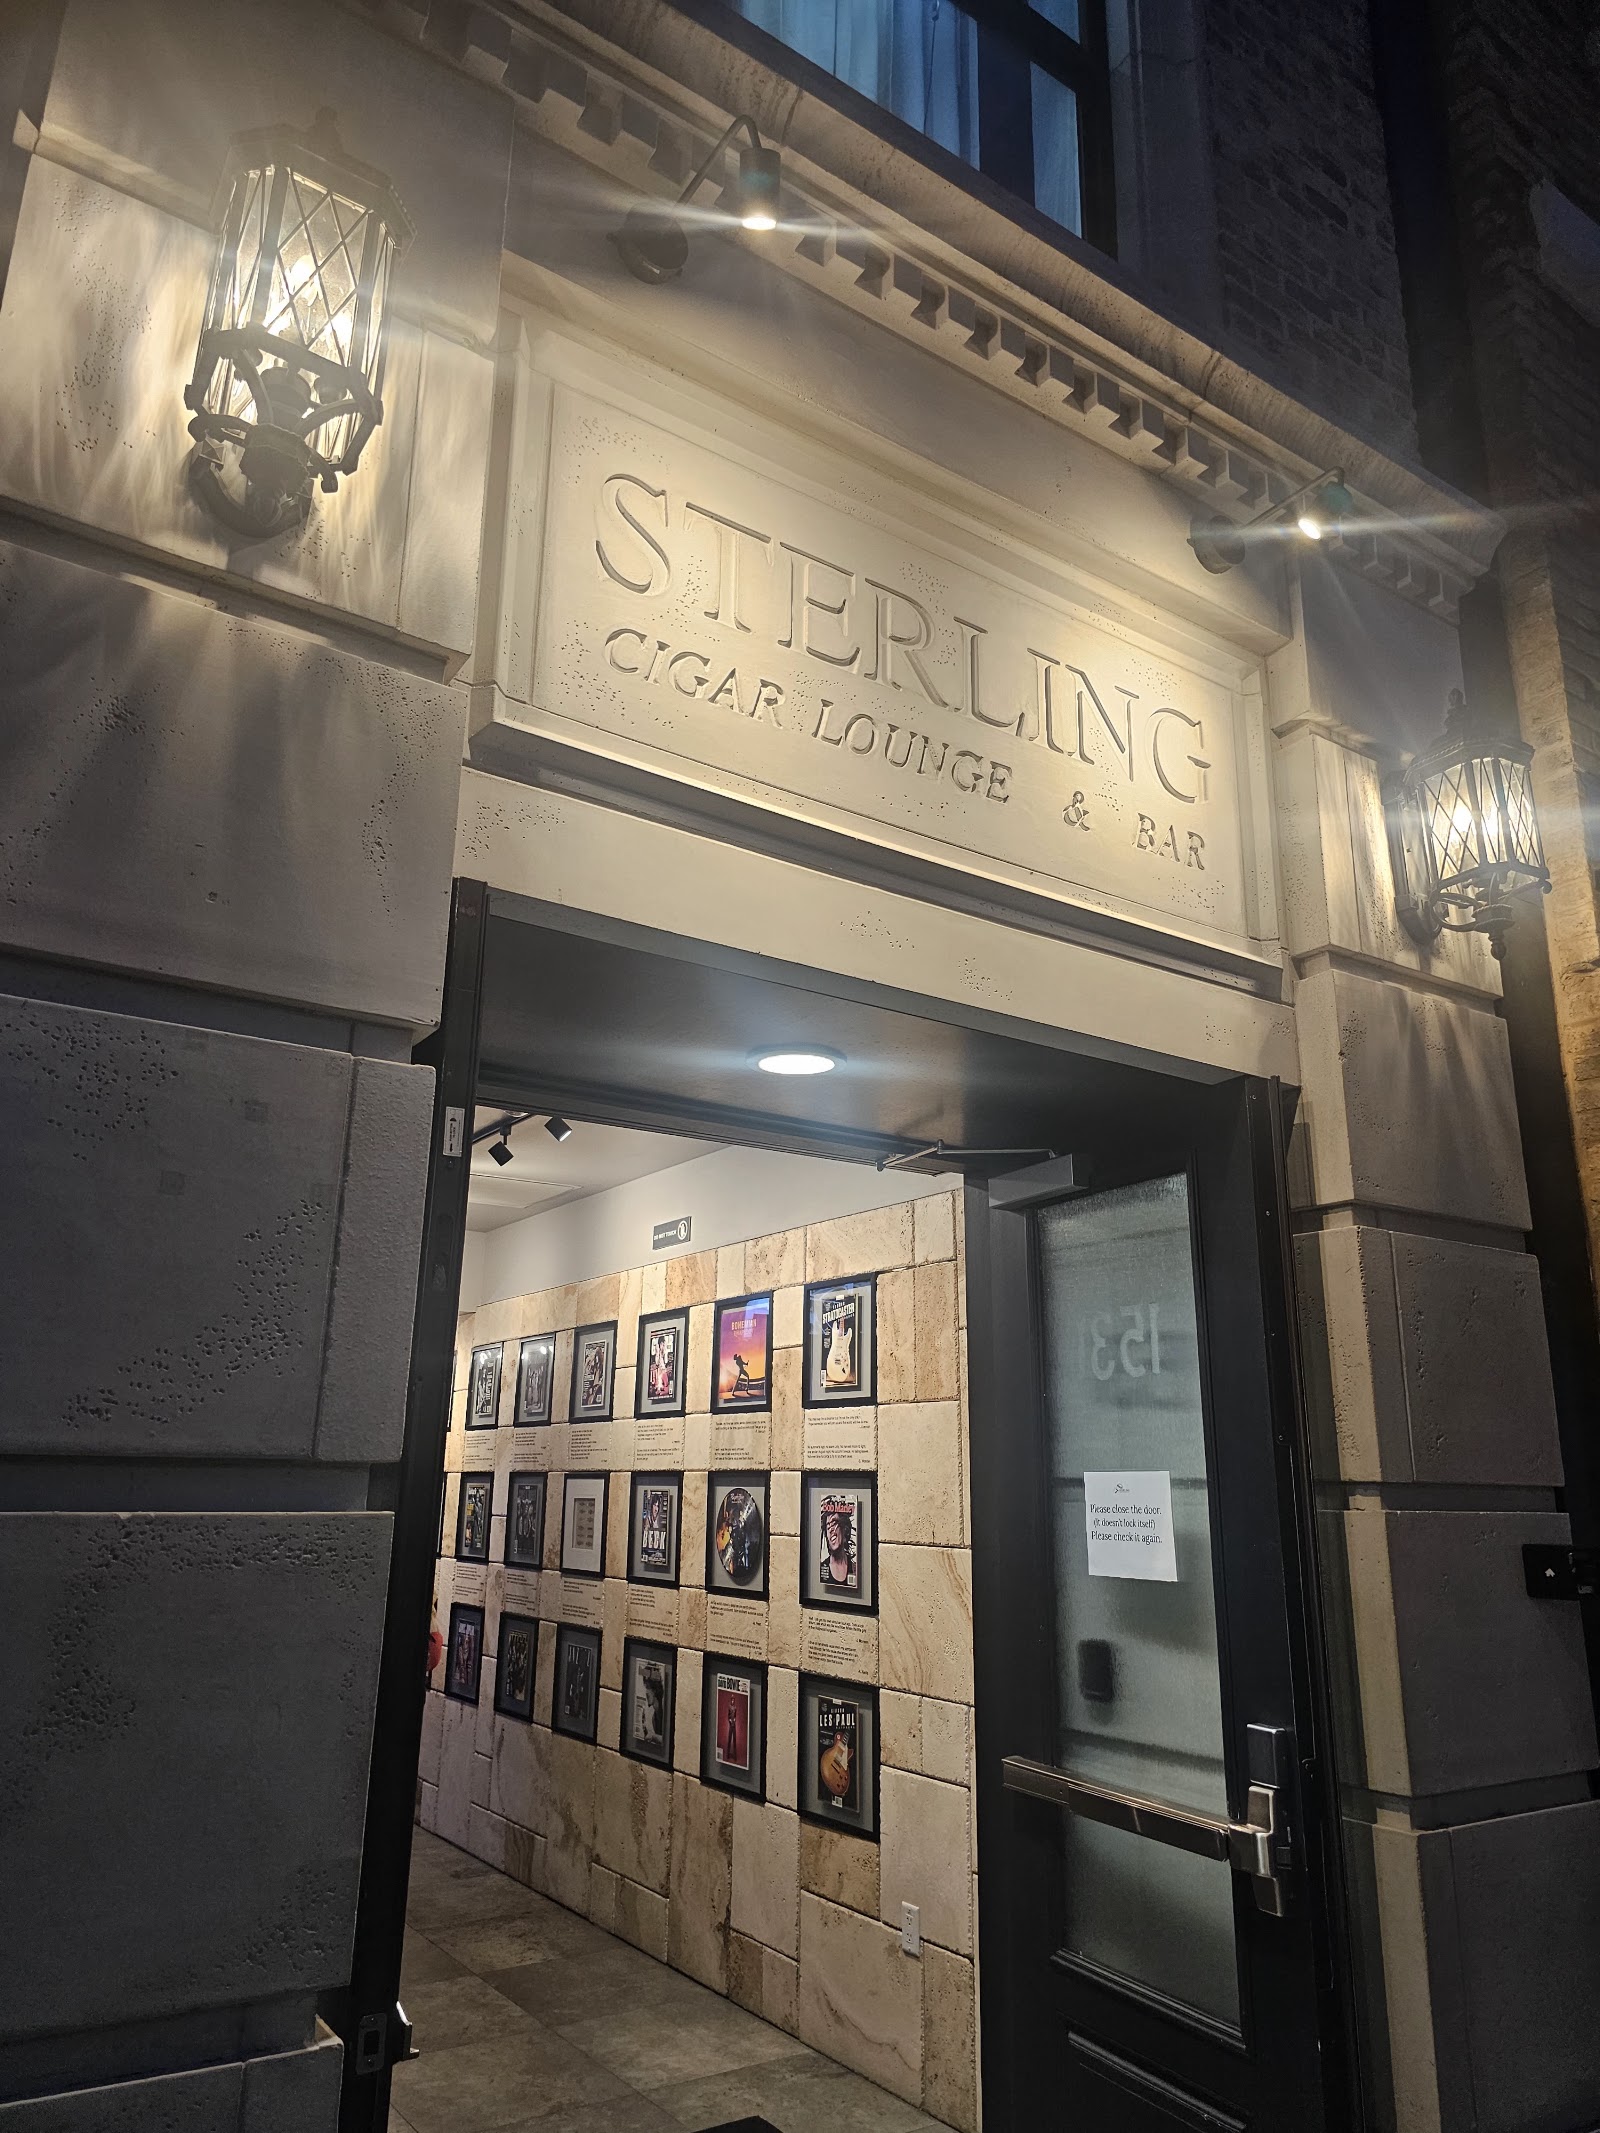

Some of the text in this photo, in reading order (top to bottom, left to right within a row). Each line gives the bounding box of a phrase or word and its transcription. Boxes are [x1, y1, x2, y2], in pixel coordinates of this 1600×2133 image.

[593, 473, 1212, 804] STERLING
[604, 627, 1206, 871] CIGAR LOUNGE & BAR
[1090, 1503, 1162, 1515] Please close the door.
[1101, 1518, 1123, 1527] doesn't
[1123, 1518, 1136, 1528] lock
[1137, 1519, 1156, 1530] itself)
[1091, 1530, 1163, 1546] Please check it again.
[819, 1712, 856, 1727] LES PAUL
